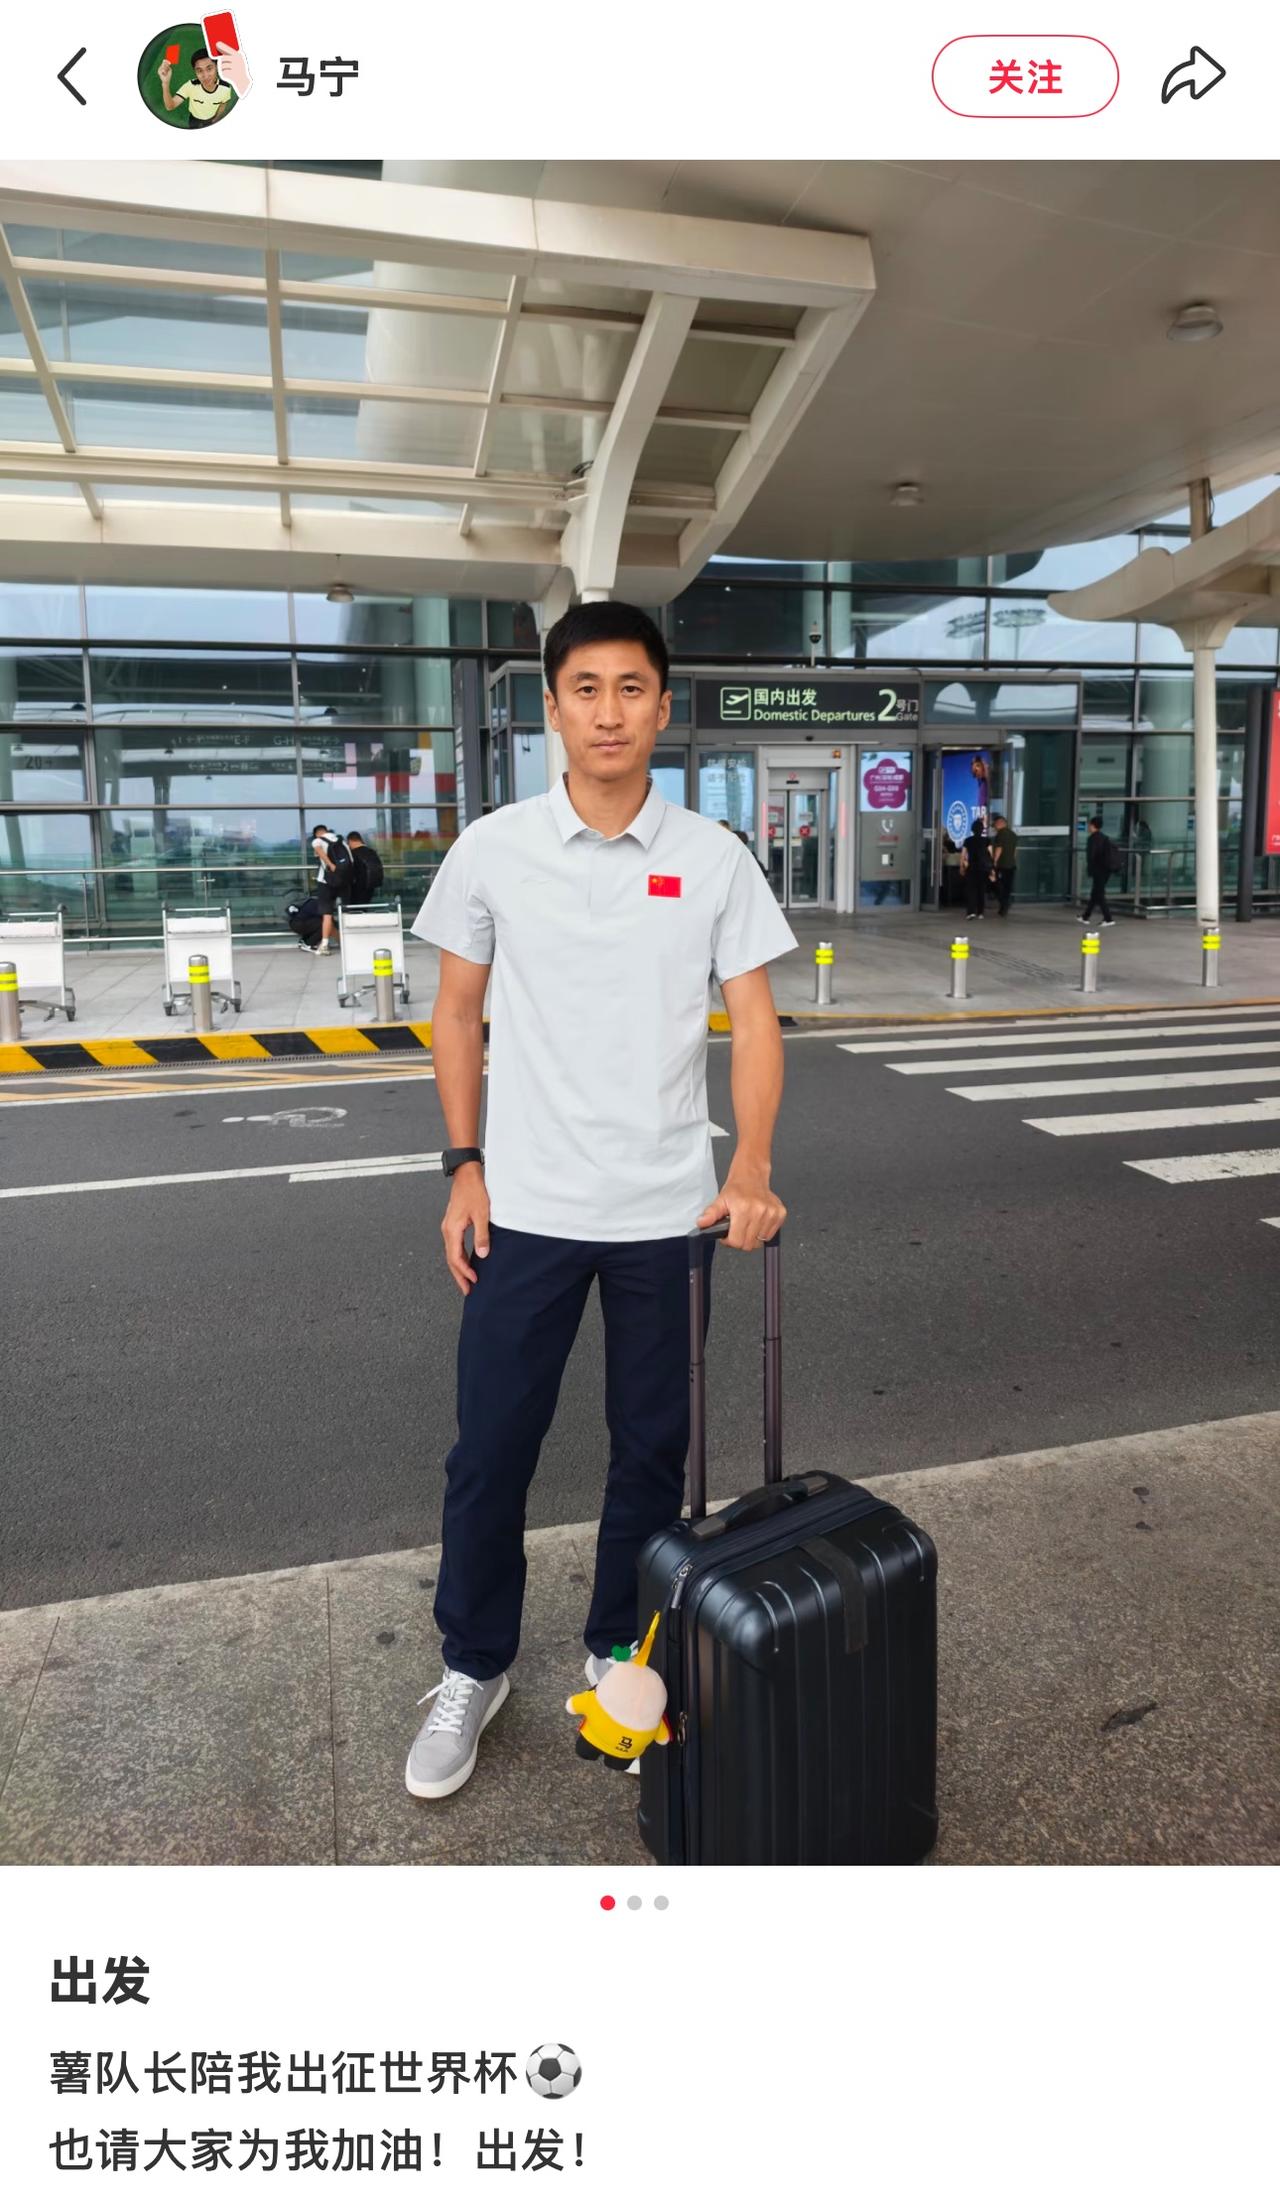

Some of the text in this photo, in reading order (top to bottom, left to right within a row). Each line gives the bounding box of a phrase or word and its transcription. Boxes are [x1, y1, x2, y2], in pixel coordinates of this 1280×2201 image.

[753, 687, 818, 706] 国内出发
[877, 688, 898, 722] 2
[753, 708, 876, 724] Domestic Departures
[896, 712, 919, 722] Gate
[618, 1735, 633, 1749] 马
